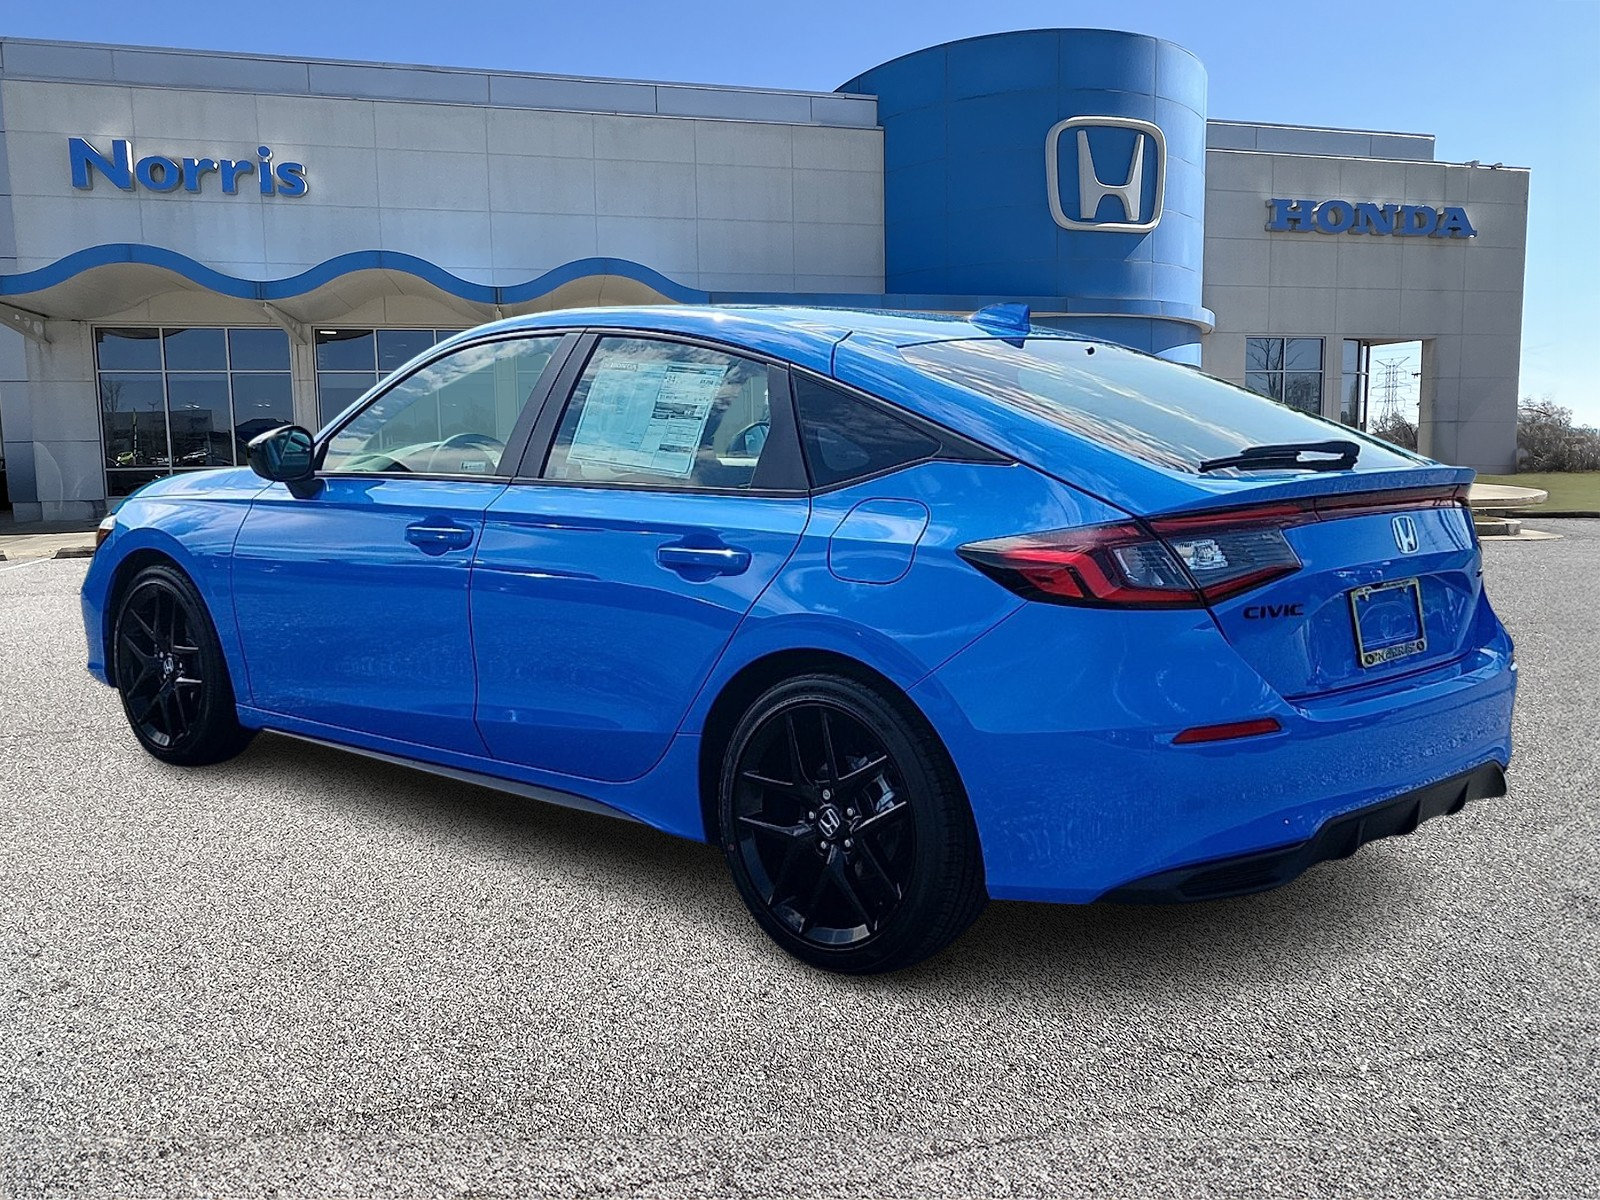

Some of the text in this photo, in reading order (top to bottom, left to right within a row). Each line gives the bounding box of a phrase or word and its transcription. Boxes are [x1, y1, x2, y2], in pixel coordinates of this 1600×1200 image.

[68, 137, 308, 197] Norris
[1265, 198, 1478, 239] HONDA
[1243, 602, 1304, 620] CIVIC
